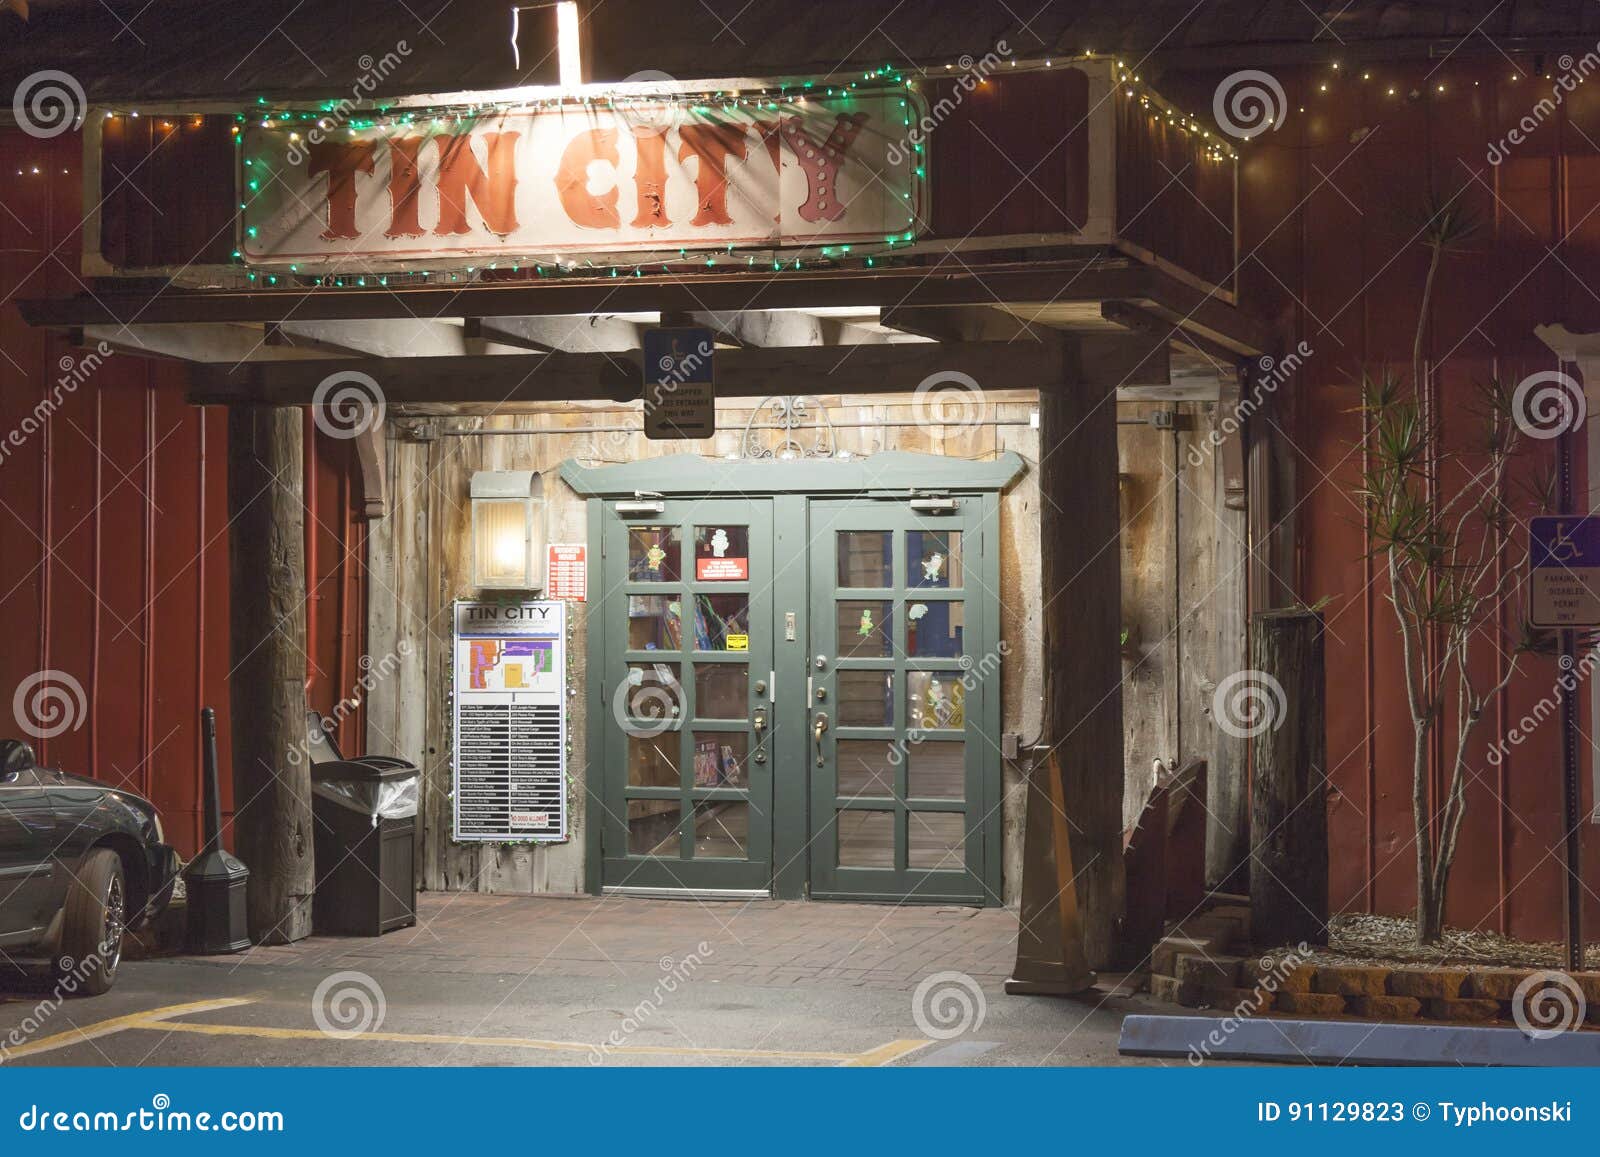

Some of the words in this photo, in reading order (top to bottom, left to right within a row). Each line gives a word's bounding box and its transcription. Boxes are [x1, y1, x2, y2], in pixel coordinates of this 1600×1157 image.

[307, 130, 522, 241] TIN
[553, 111, 871, 232] CITY
[465, 607, 498, 620] TIN
[504, 607, 550, 620] CITY
